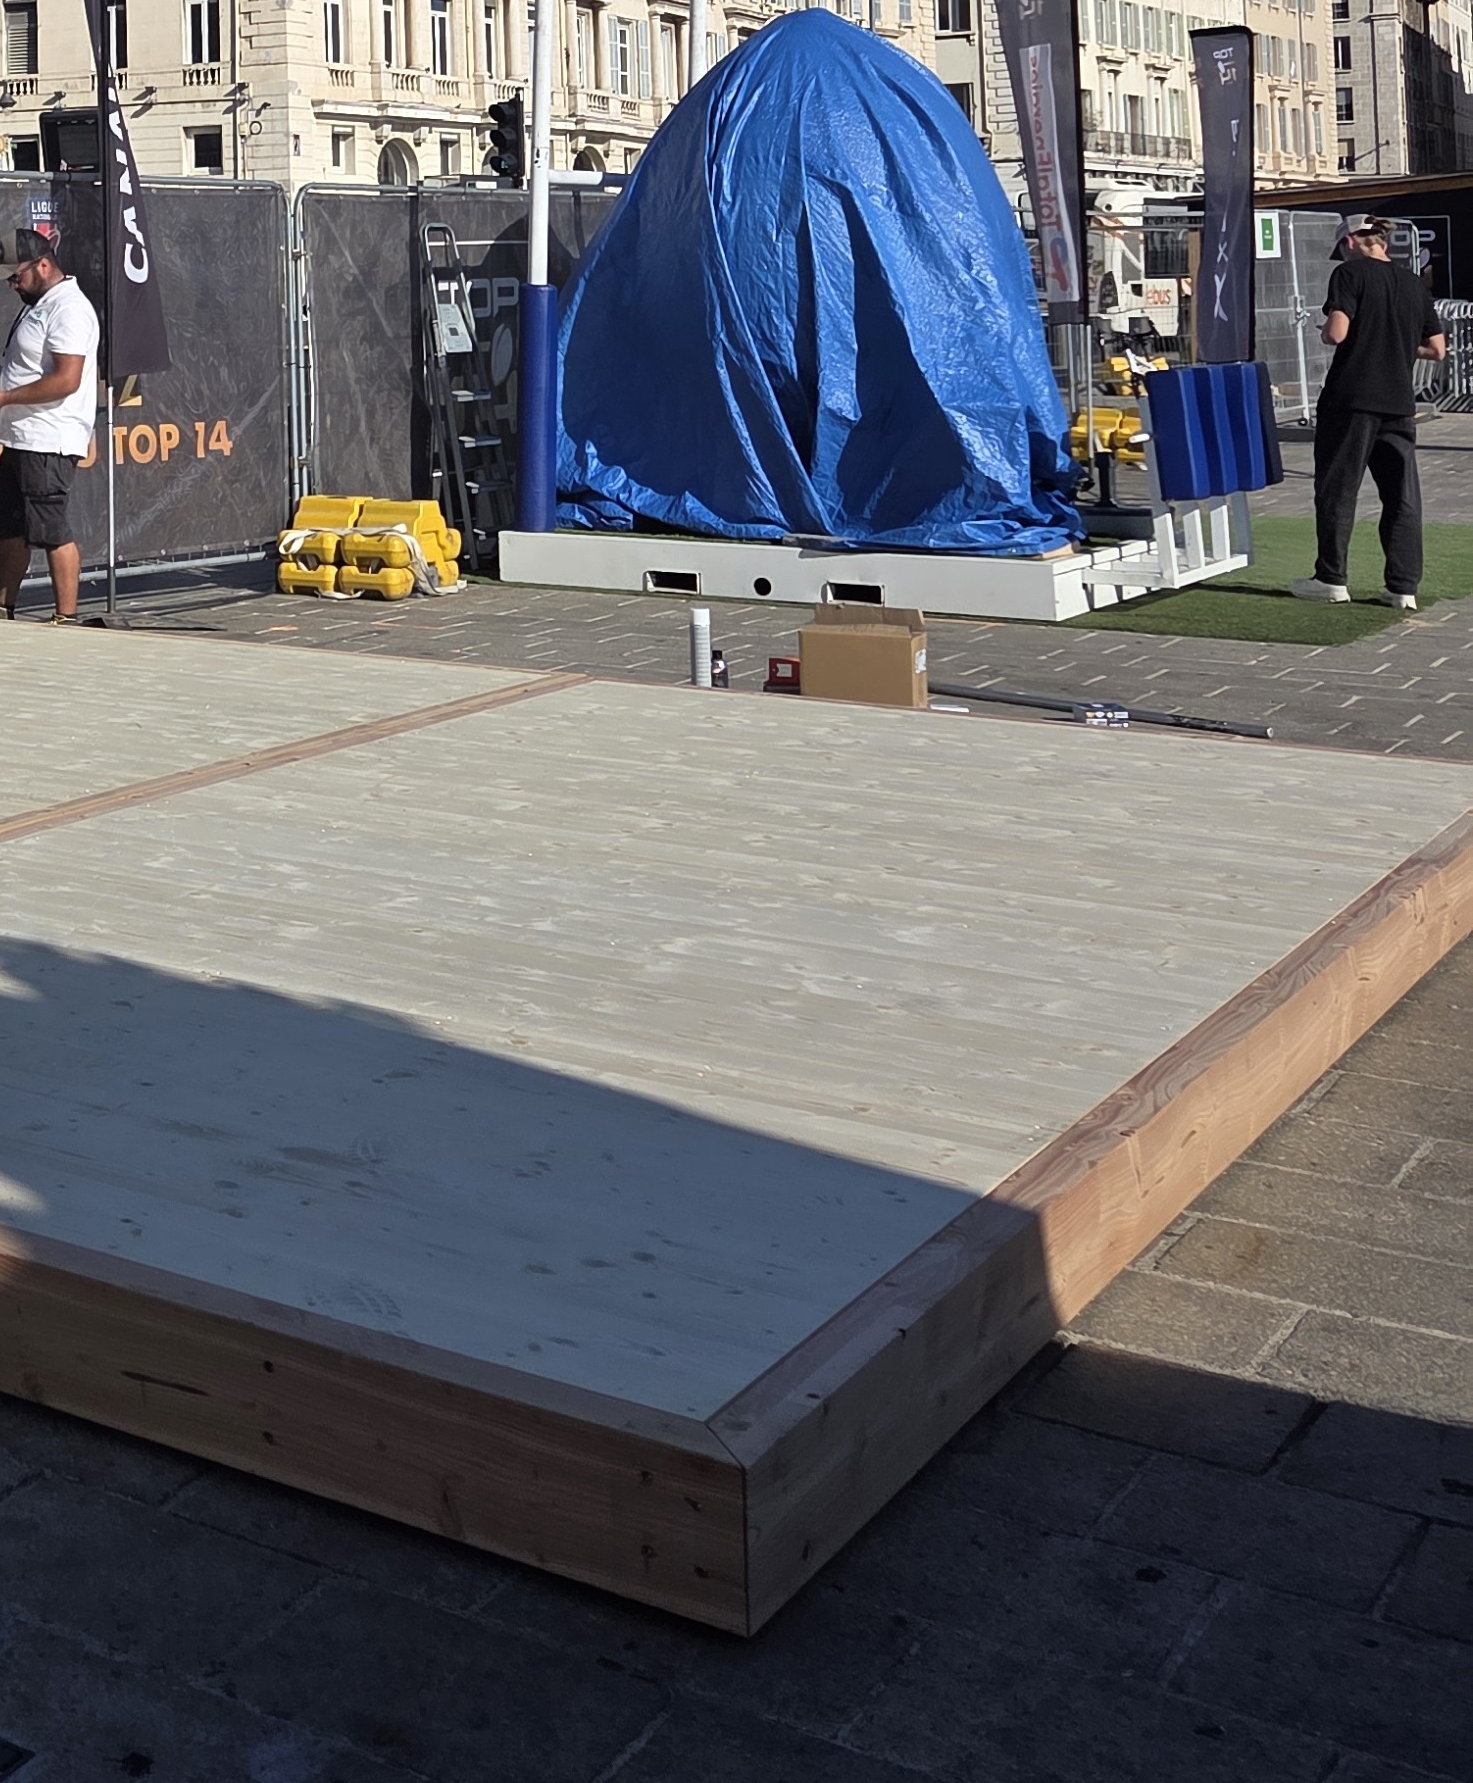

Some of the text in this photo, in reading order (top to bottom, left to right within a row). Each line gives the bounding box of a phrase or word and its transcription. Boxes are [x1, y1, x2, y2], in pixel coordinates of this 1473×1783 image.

[31, 201, 59, 214] LIGUE
[1390, 229, 1436, 247] OP
[113, 422, 180, 465] TOP
[194, 420, 234, 459] 14
